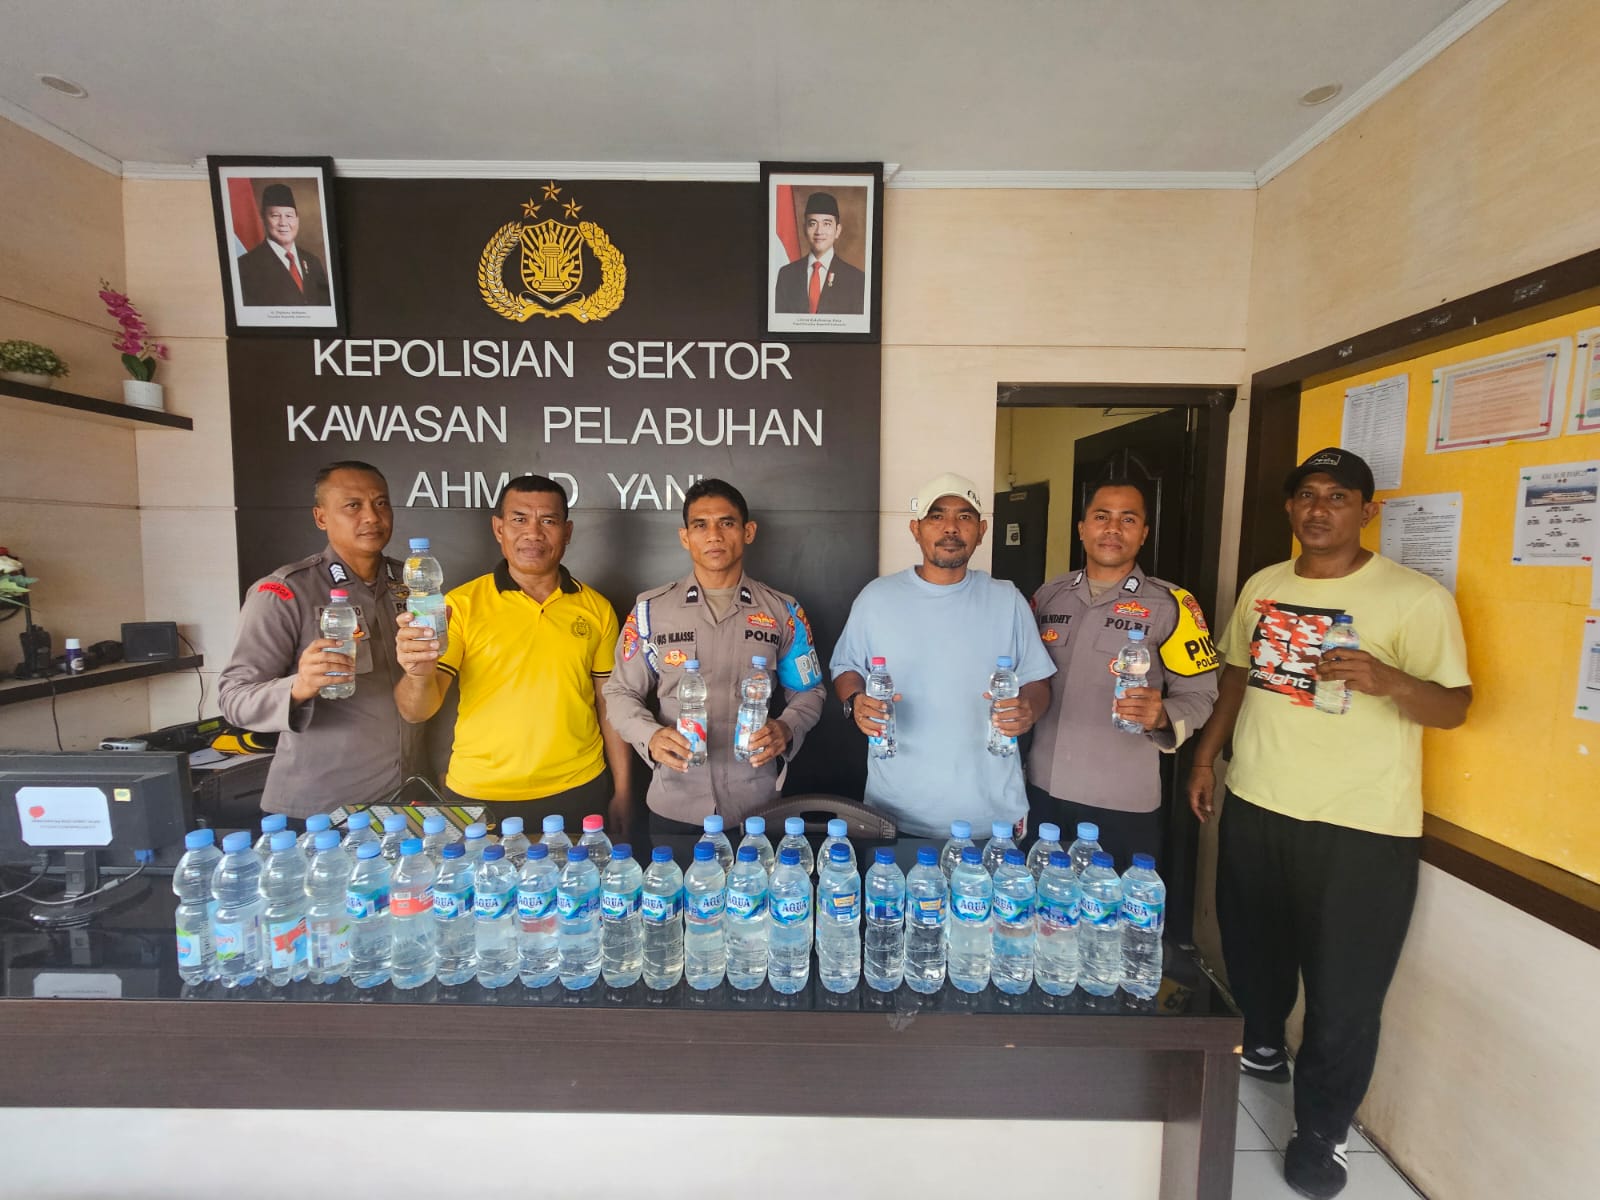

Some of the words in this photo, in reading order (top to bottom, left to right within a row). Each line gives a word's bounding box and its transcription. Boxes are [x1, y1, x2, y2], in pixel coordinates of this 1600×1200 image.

[313, 338, 574, 378] KEPOLISIAN
[607, 341, 793, 380] SEKTOR
[286, 405, 507, 443] KAWASAN
[543, 406, 823, 446] PELABUHAN
[405, 470, 579, 508] AHMD
[607, 472, 703, 511] YAN
[1104, 617, 1151, 636] POLRI
[744, 629, 780, 646] POLRI
[1249, 668, 1313, 690] nsight
[781, 900, 807, 914] AQUA
[960, 899, 987, 913] AQUA
